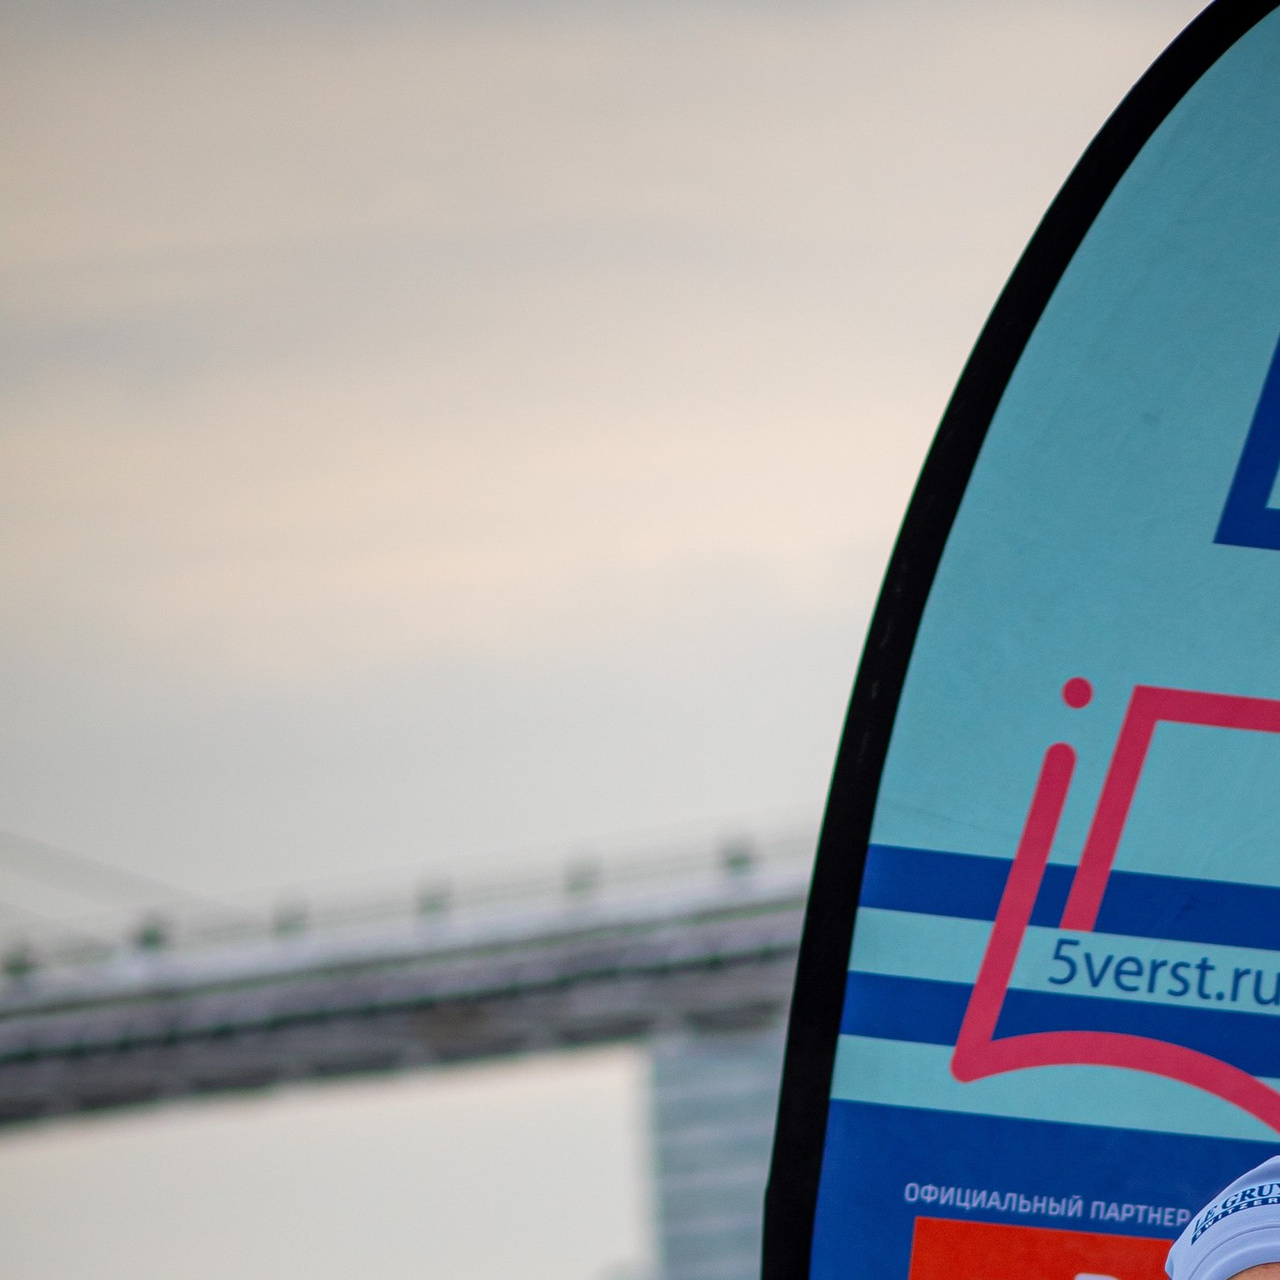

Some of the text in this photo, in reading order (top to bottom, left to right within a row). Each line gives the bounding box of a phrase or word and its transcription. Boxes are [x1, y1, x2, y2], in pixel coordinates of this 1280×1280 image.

[904, 1182, 1191, 1227] ОФИЦИАЛЬНЫЙ ПАРТНЕР
[1194, 1205, 1217, 1234] LE
